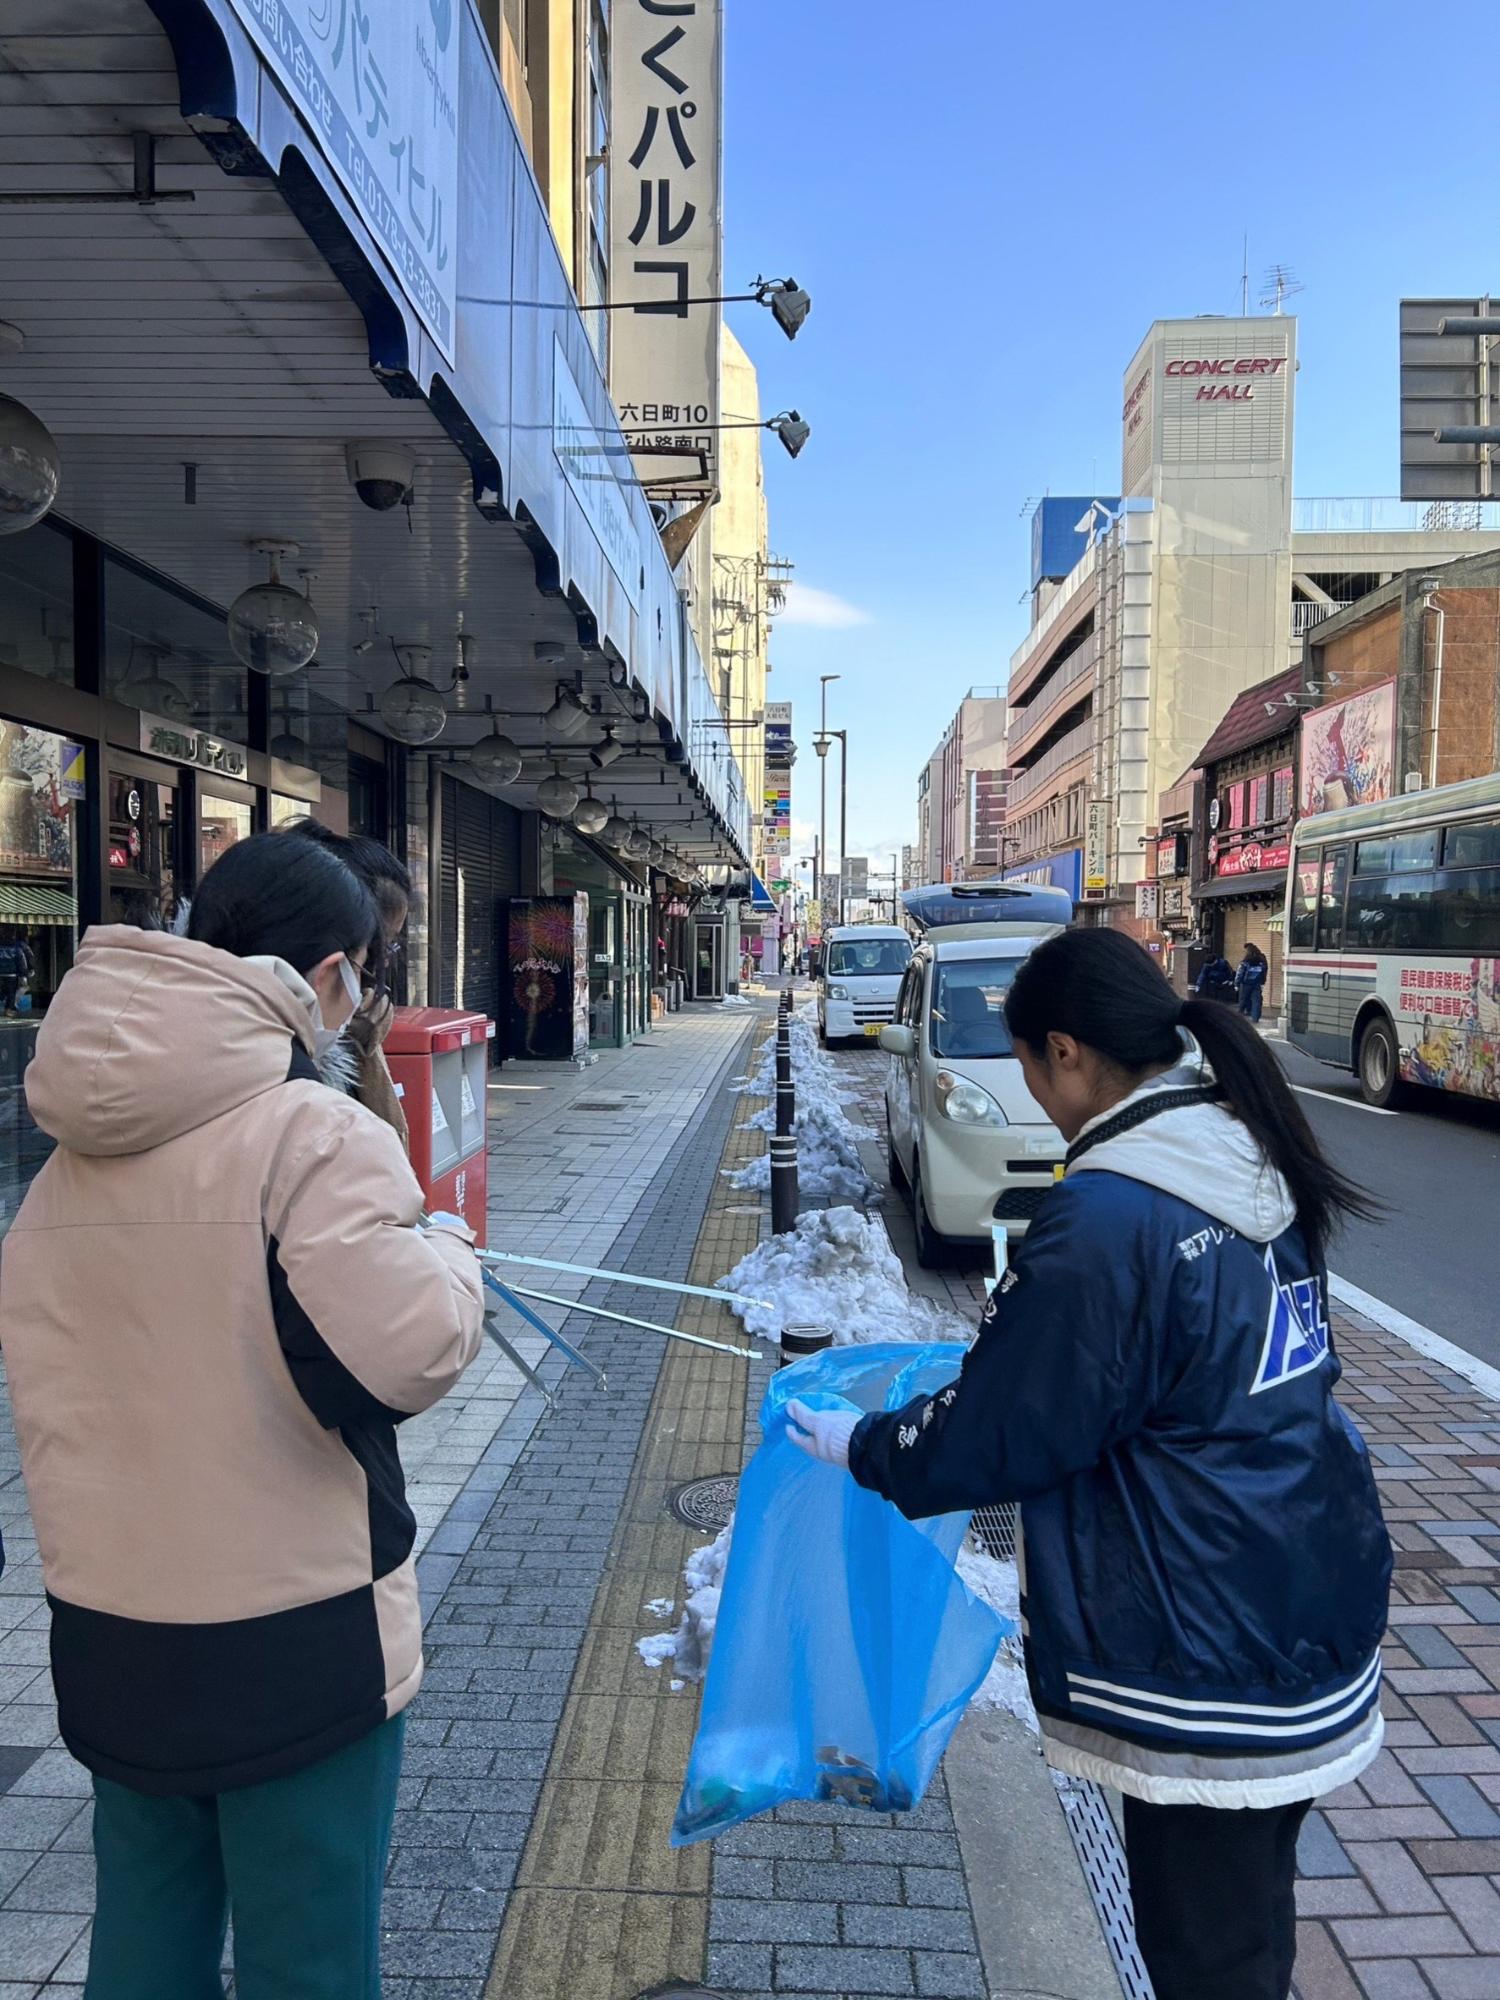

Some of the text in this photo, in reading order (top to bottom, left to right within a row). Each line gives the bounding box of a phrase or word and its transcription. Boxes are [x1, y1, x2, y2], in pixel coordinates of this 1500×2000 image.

[346, 131, 441, 331] Tel.0178-43-3831
[1165, 358, 1287, 377] CONCERT
[1195, 384, 1254, 400] HALL
[619, 402, 708, 423] 六日町10
[1400, 969, 1472, 992] 国民健康保険税は
